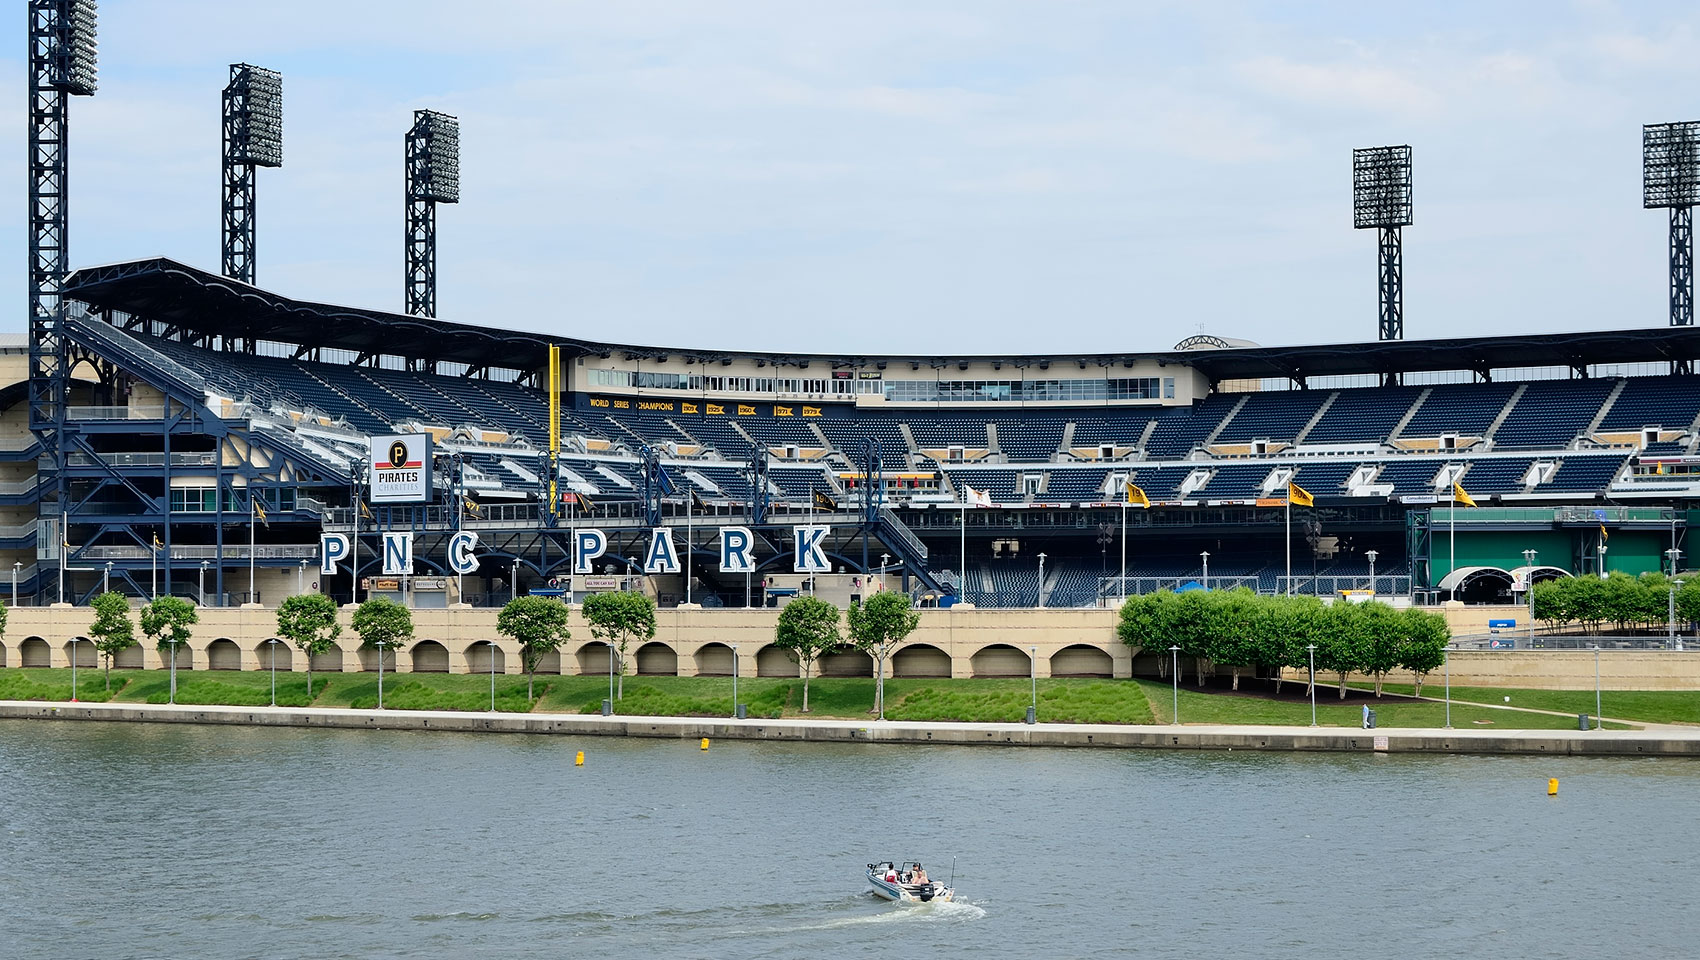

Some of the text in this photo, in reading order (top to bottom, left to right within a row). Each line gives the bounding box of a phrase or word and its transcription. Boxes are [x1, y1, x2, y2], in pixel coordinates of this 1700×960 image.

[590, 398, 674, 410] WORLD SERIES CHAMPIONS
[394, 446, 403, 464] P
[378, 472, 418, 483] PIRATES
[378, 484, 418, 492] CHARITIES
[466, 501, 480, 512] 971
[320, 524, 832, 574] PNC PARK
